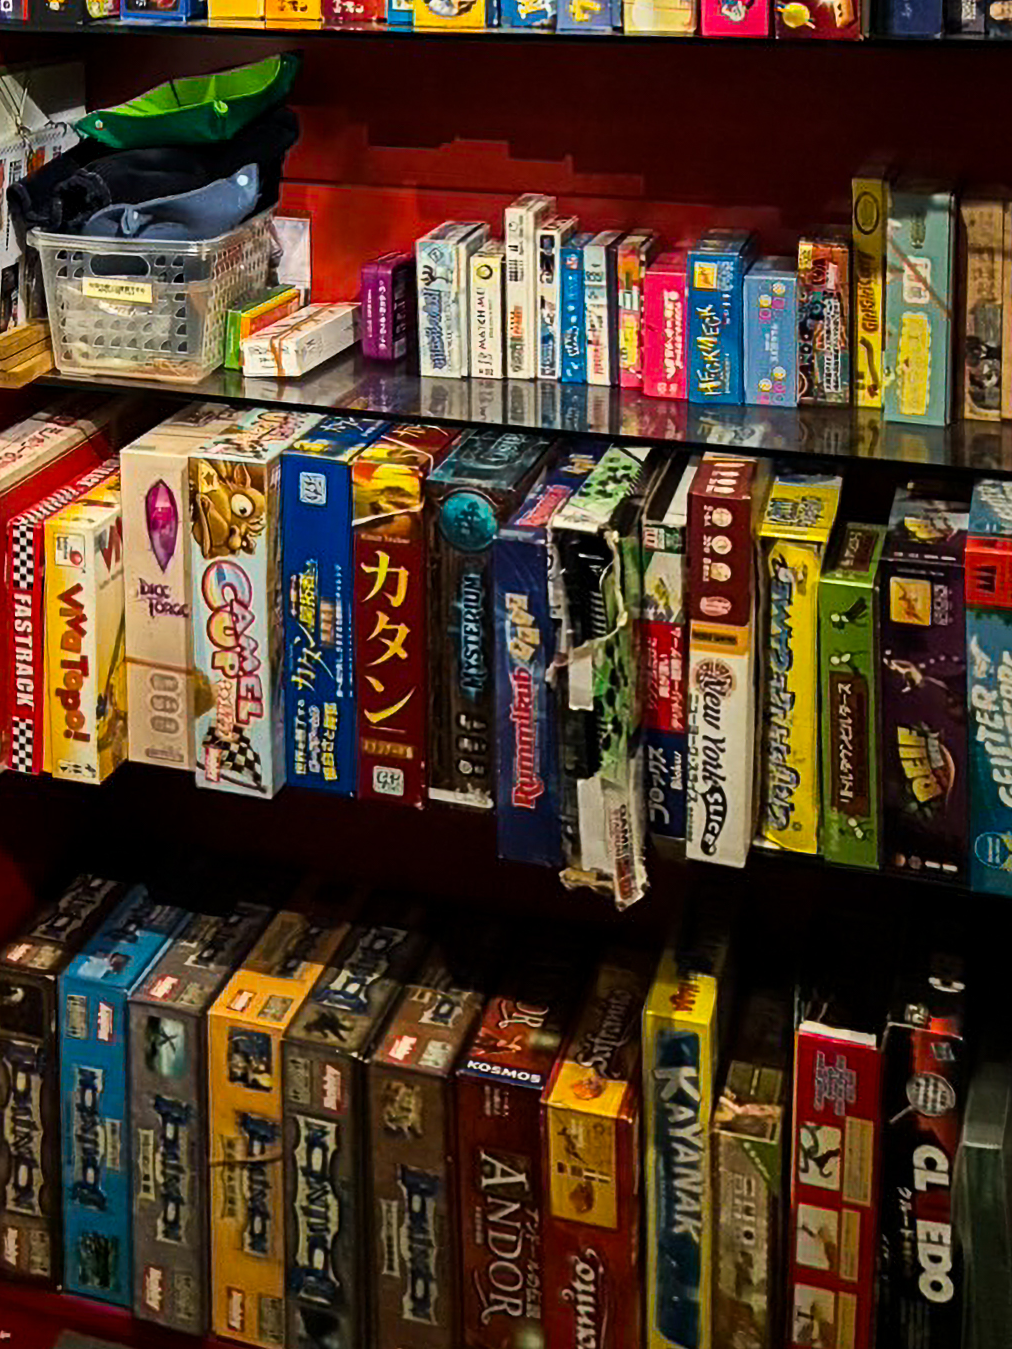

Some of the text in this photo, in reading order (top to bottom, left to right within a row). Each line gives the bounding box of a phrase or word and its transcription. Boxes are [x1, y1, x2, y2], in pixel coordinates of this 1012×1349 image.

[696, 303, 722, 396] HECKMECK
[13, 590, 34, 714] FASTRACK
[290, 621, 334, 692] カタン
[360, 549, 417, 724] カタン
[460, 571, 484, 694] MYSTERIUM
[510, 662, 546, 811] Rummikub
[701, 675, 726, 847] New York SLICE
[896, 724, 941, 801] REEF
[466, 1058, 542, 1085] KOSMOS
[650, 1065, 704, 1245] KAYANAK
[911, 1143, 955, 1303] CLEDO
[479, 1149, 529, 1326] ANDOR
